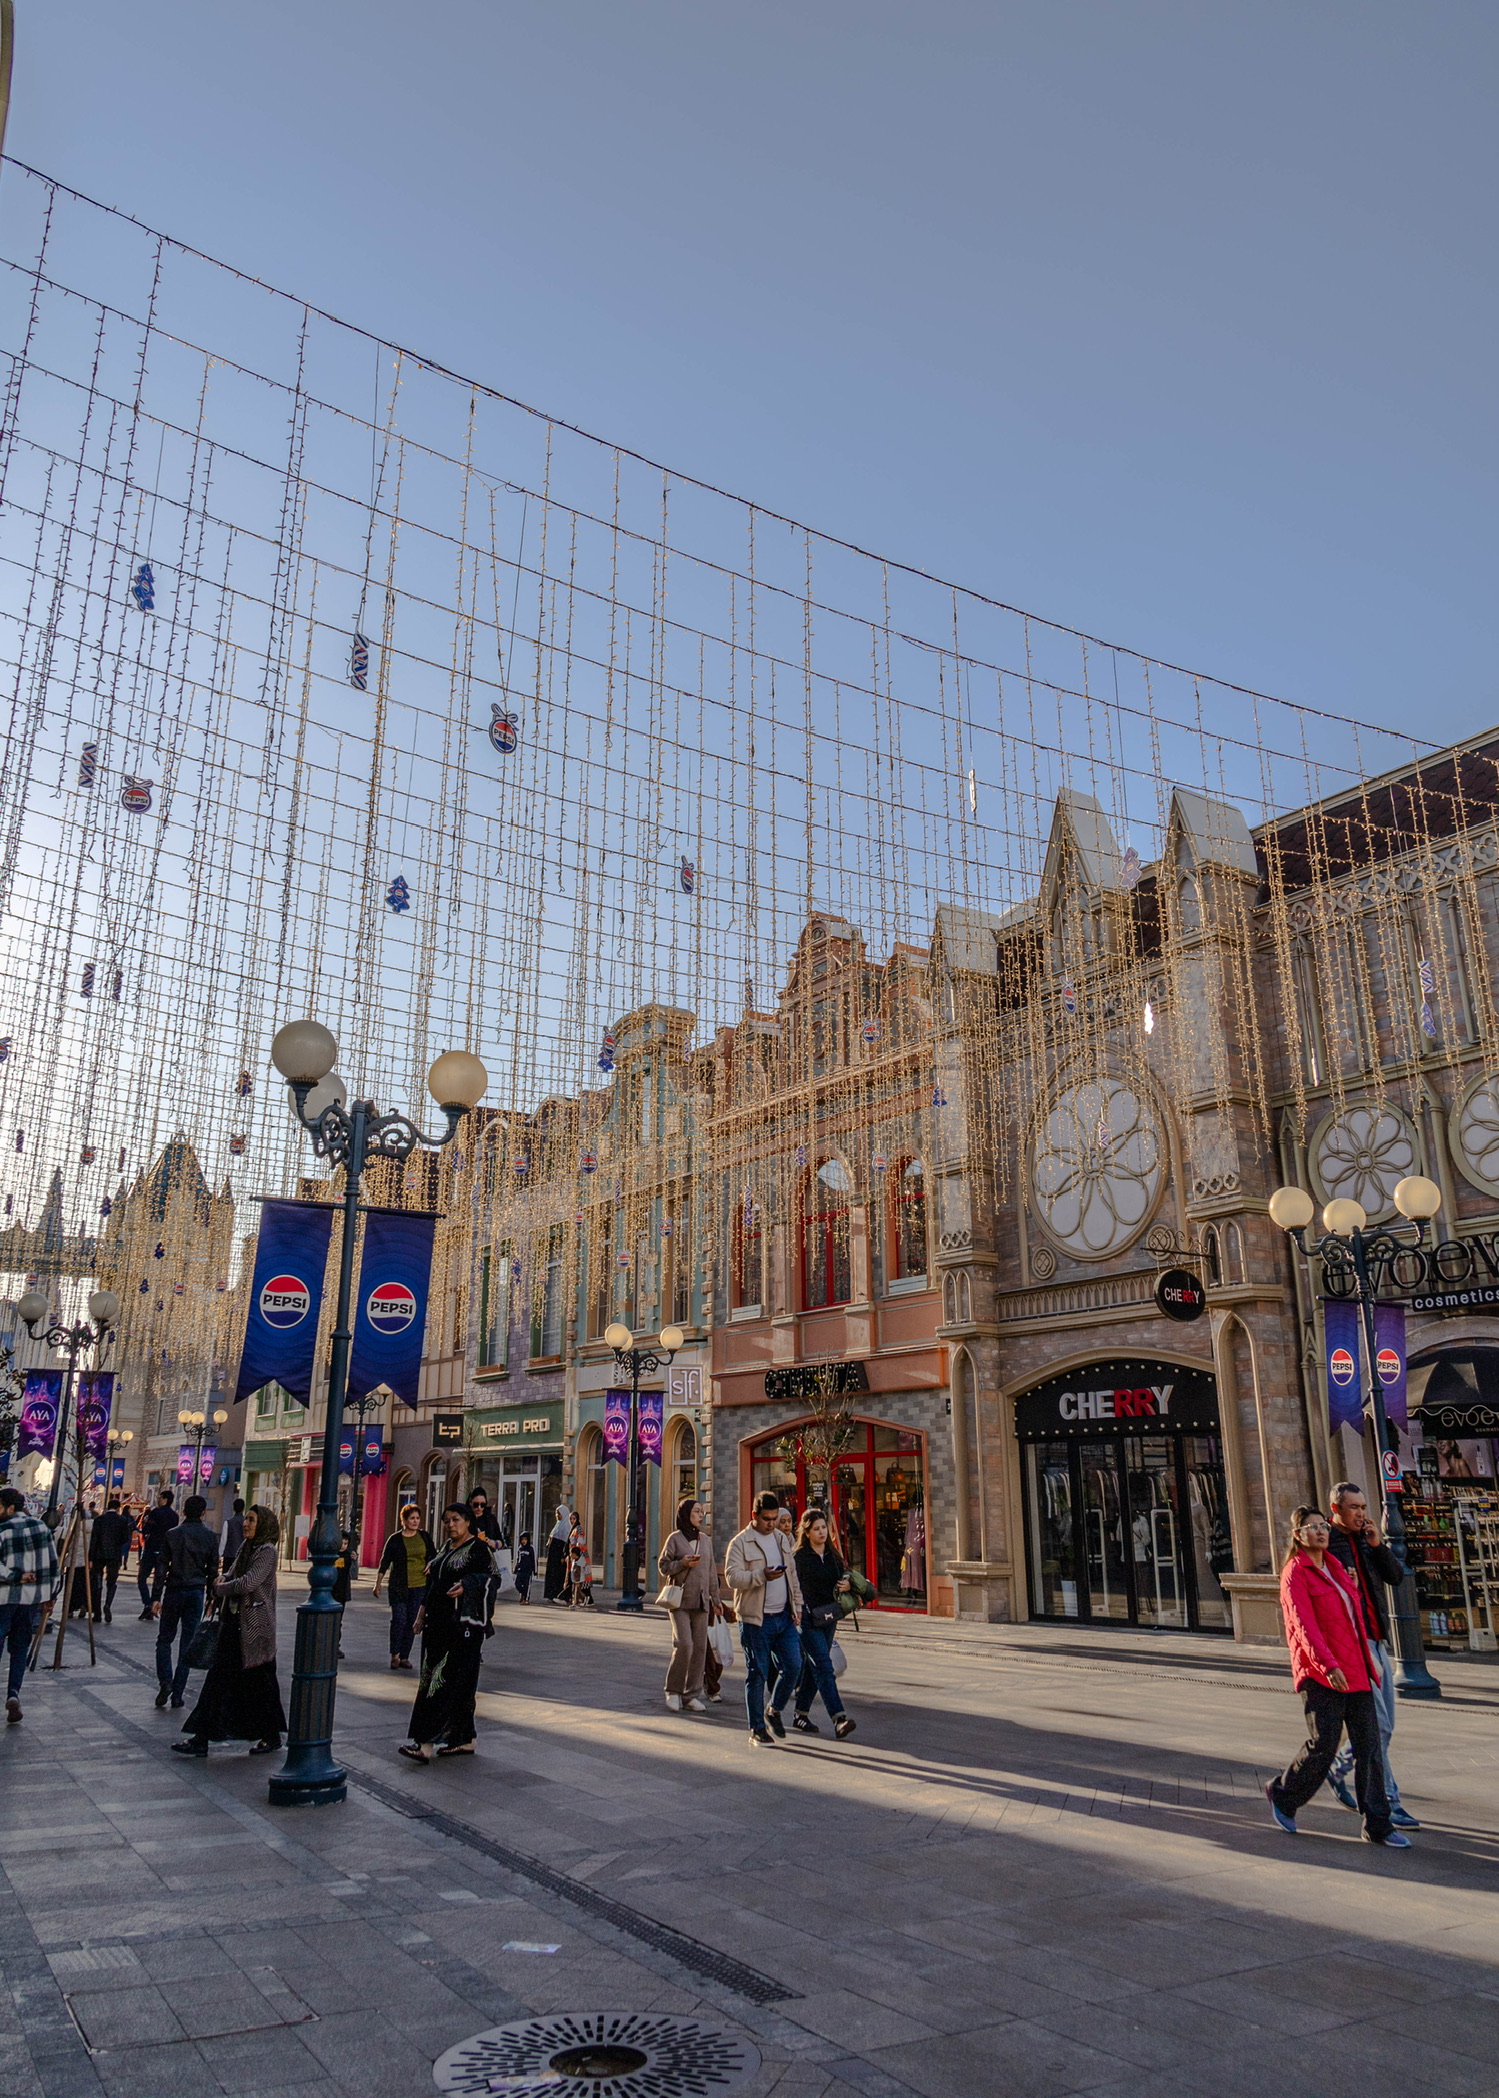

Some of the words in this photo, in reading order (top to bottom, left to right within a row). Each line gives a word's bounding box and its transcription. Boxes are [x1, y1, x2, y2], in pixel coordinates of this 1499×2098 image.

[494, 727, 514, 744] PEPSI
[125, 796, 148, 804] PEPSI
[263, 1293, 307, 1309] PEPSI
[1164, 1287, 1200, 1304] CHERRY
[370, 1301, 413, 1315] PEPSI
[1332, 1362, 1352, 1371] PEPSI
[1377, 1361, 1399, 1371] PEPSI
[1059, 1385, 1174, 1420] CHERRY
[29, 1409, 50, 1421] AYA
[1441, 1409, 1499, 1428] evoe
[480, 1421, 519, 1437] TERRA
[522, 1417, 550, 1433] PRO
[608, 1422, 624, 1433] AYA
[641, 1424, 657, 1434] AYA
